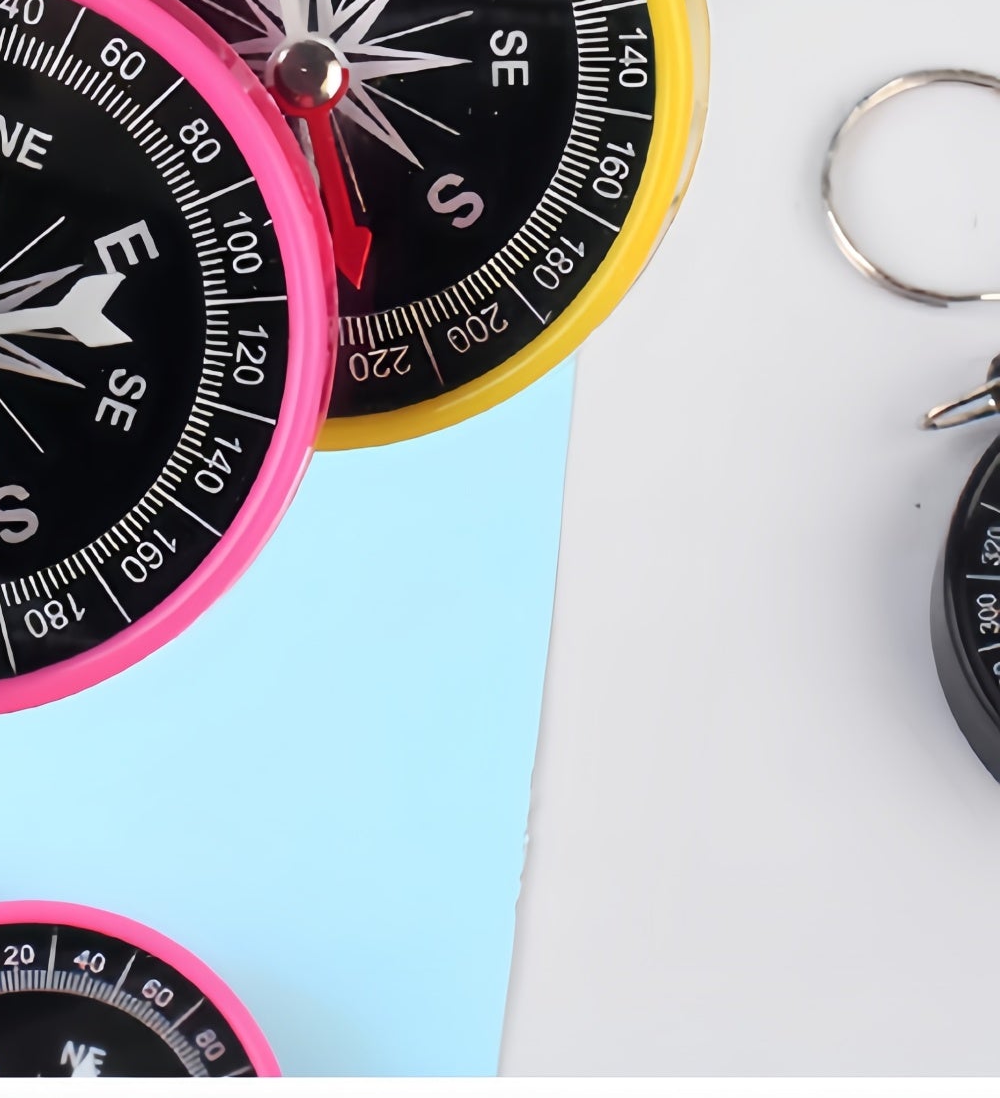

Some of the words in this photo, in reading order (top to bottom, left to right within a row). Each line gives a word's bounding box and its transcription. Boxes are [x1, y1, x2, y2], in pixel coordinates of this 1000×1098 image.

[100, 37, 147, 81] 60
[489, 28, 529, 88] SE
[616, 27, 649, 88] 140
[178, 117, 221, 165] 80
[591, 139, 635, 199] 160
[426, 172, 485, 230] S
[93, 219, 161, 275] E
[222, 210, 264, 277] 100
[532, 242, 588, 290] 180
[446, 304, 509, 354] 200
[232, 325, 267, 387] 120
[348, 344, 411, 383] 220
[94, 366, 147, 433] SE
[195, 435, 243, 495] 140
[123, 527, 178, 585] 160
[24, 594, 86, 639] 180
[976, 593, 1000, 635] 300
[3, 944, 36, 966] 20
[73, 949, 106, 974] 40
[141, 978, 174, 1008] 60
[195, 1028, 226, 1063] 80
